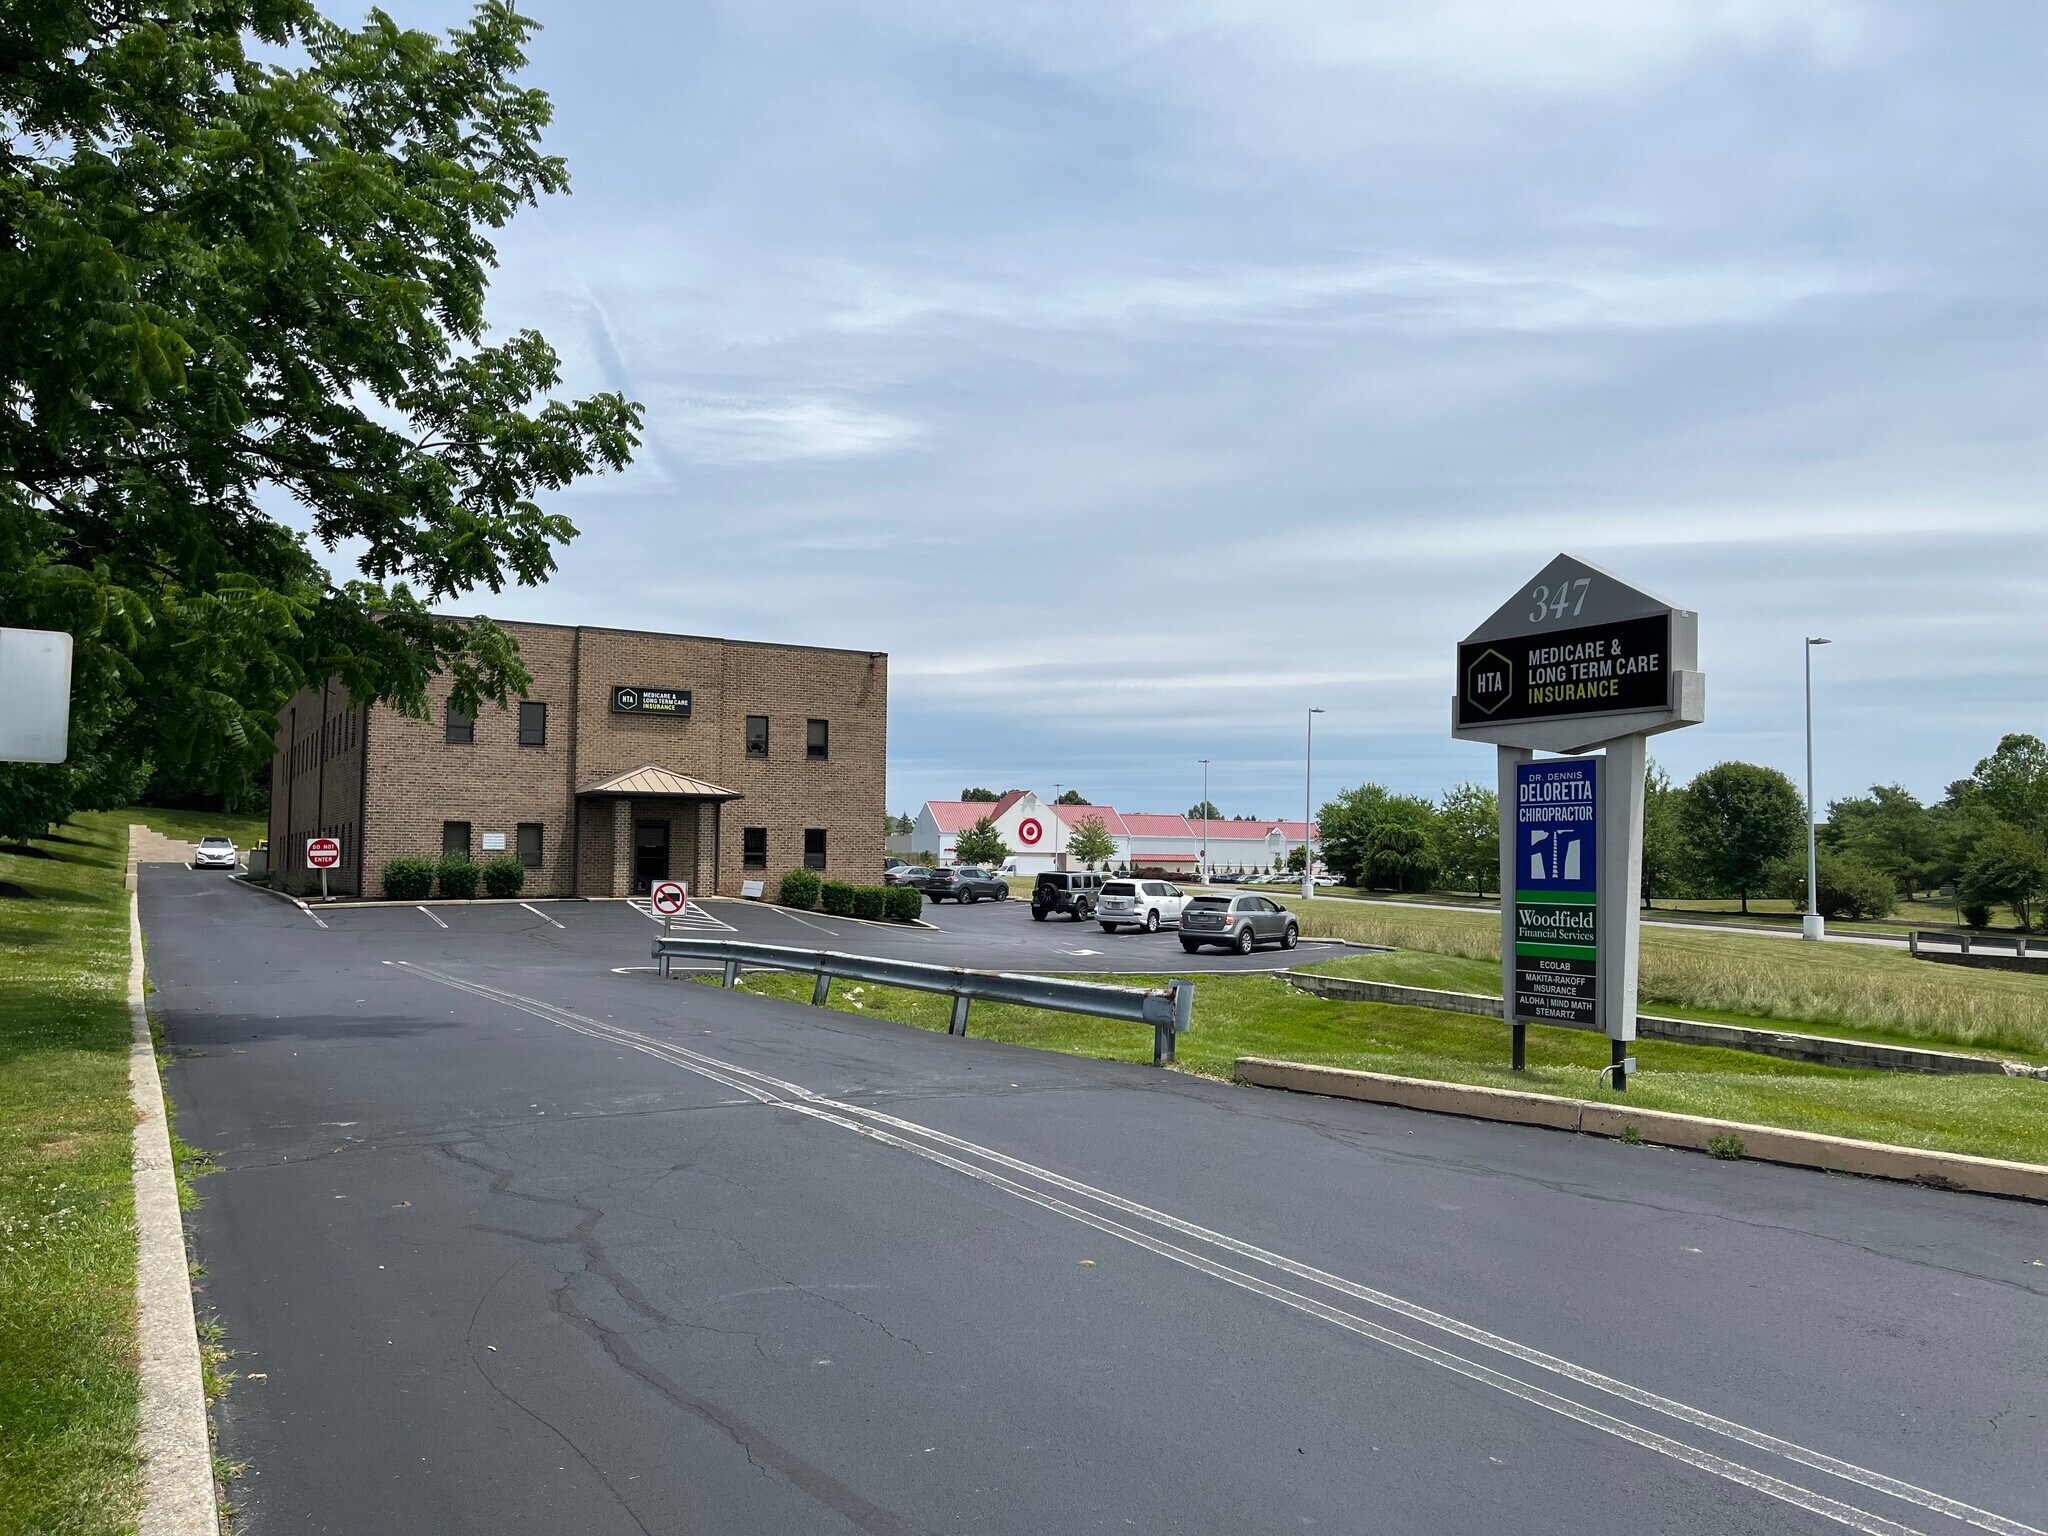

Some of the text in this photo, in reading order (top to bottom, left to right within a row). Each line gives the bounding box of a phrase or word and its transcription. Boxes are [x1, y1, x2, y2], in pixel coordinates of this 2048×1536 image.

[1528, 577, 1592, 623] 347
[1528, 638, 1622, 666] MEDICARE &
[1528, 654, 1659, 685] LONG TERM CARE
[1477, 671, 1502, 694] HTA
[622, 695, 633, 703] HTA
[1528, 679, 1619, 705] INSURANCE
[1547, 771, 1583, 780] DENNIS
[1520, 781, 1592, 802] DELORETTA
[1520, 806, 1593, 822] CHIROPRACTOR
[1518, 909, 1594, 928] Woodfield
[1519, 926, 1594, 941] Financial Services
[1540, 960, 1571, 971] ECOLAB
[1525, 973, 1586, 986] MAKITA-RAKOFF
[1533, 984, 1577, 995] INSURANCE
[1520, 995, 1545, 1006] ALOHA
[1550, 998, 1569, 1008] MIND
[1571, 1000, 1592, 1011] MATH
[1535, 1007, 1576, 1019] STEMARTZ
